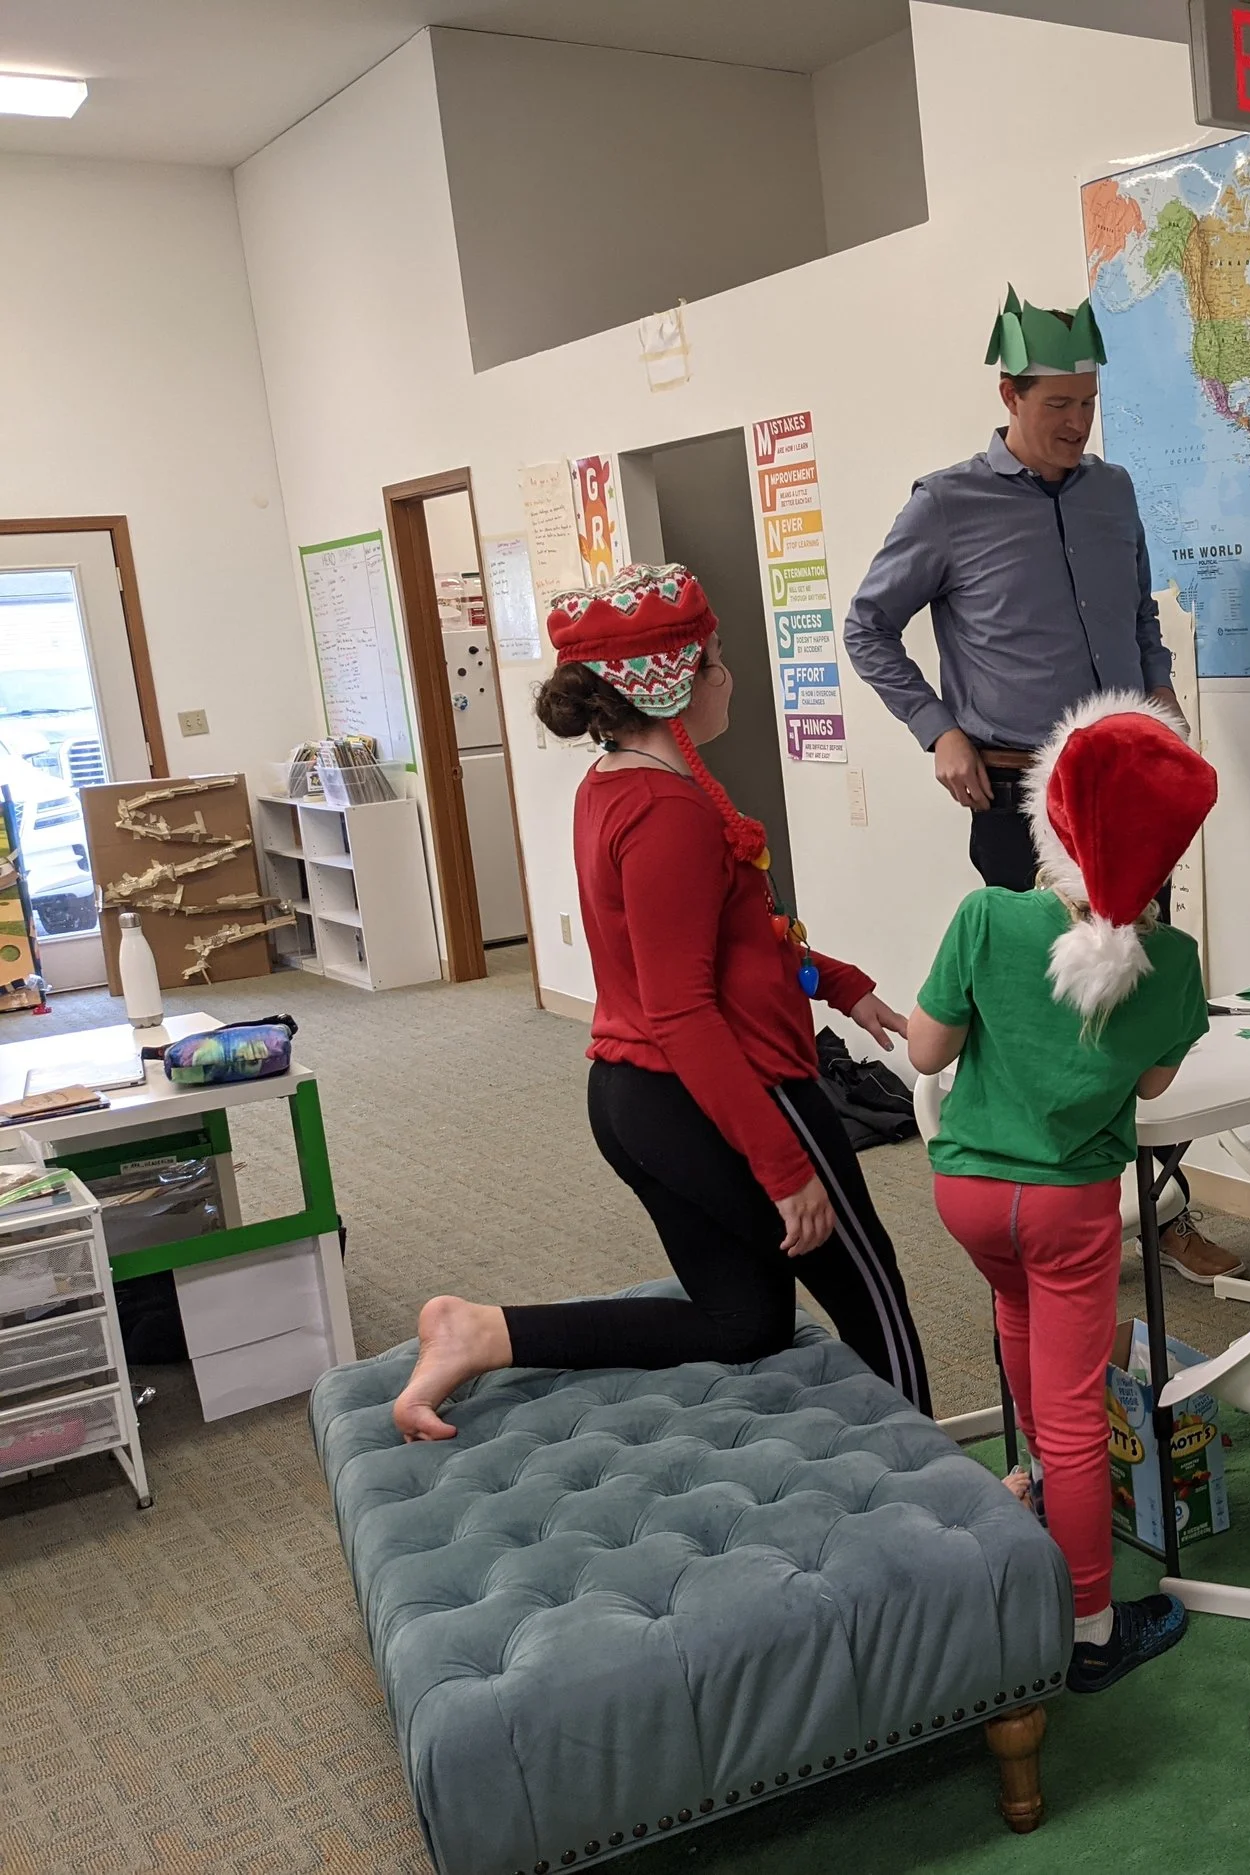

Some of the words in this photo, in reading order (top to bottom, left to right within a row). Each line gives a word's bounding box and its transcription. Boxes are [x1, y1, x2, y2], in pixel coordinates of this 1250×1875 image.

[755, 415, 806, 457] MISTAKES
[764, 467, 815, 508] IMPROVEMENT
[768, 518, 803, 553] NEVER
[1172, 548, 1194, 560] THE
[1199, 544, 1243, 558] WORLD
[772, 565, 825, 600] DETERMINATION
[779, 614, 822, 649] SUCCESS
[783, 667, 825, 701] EFFORT
[789, 719, 833, 751] THINGS
